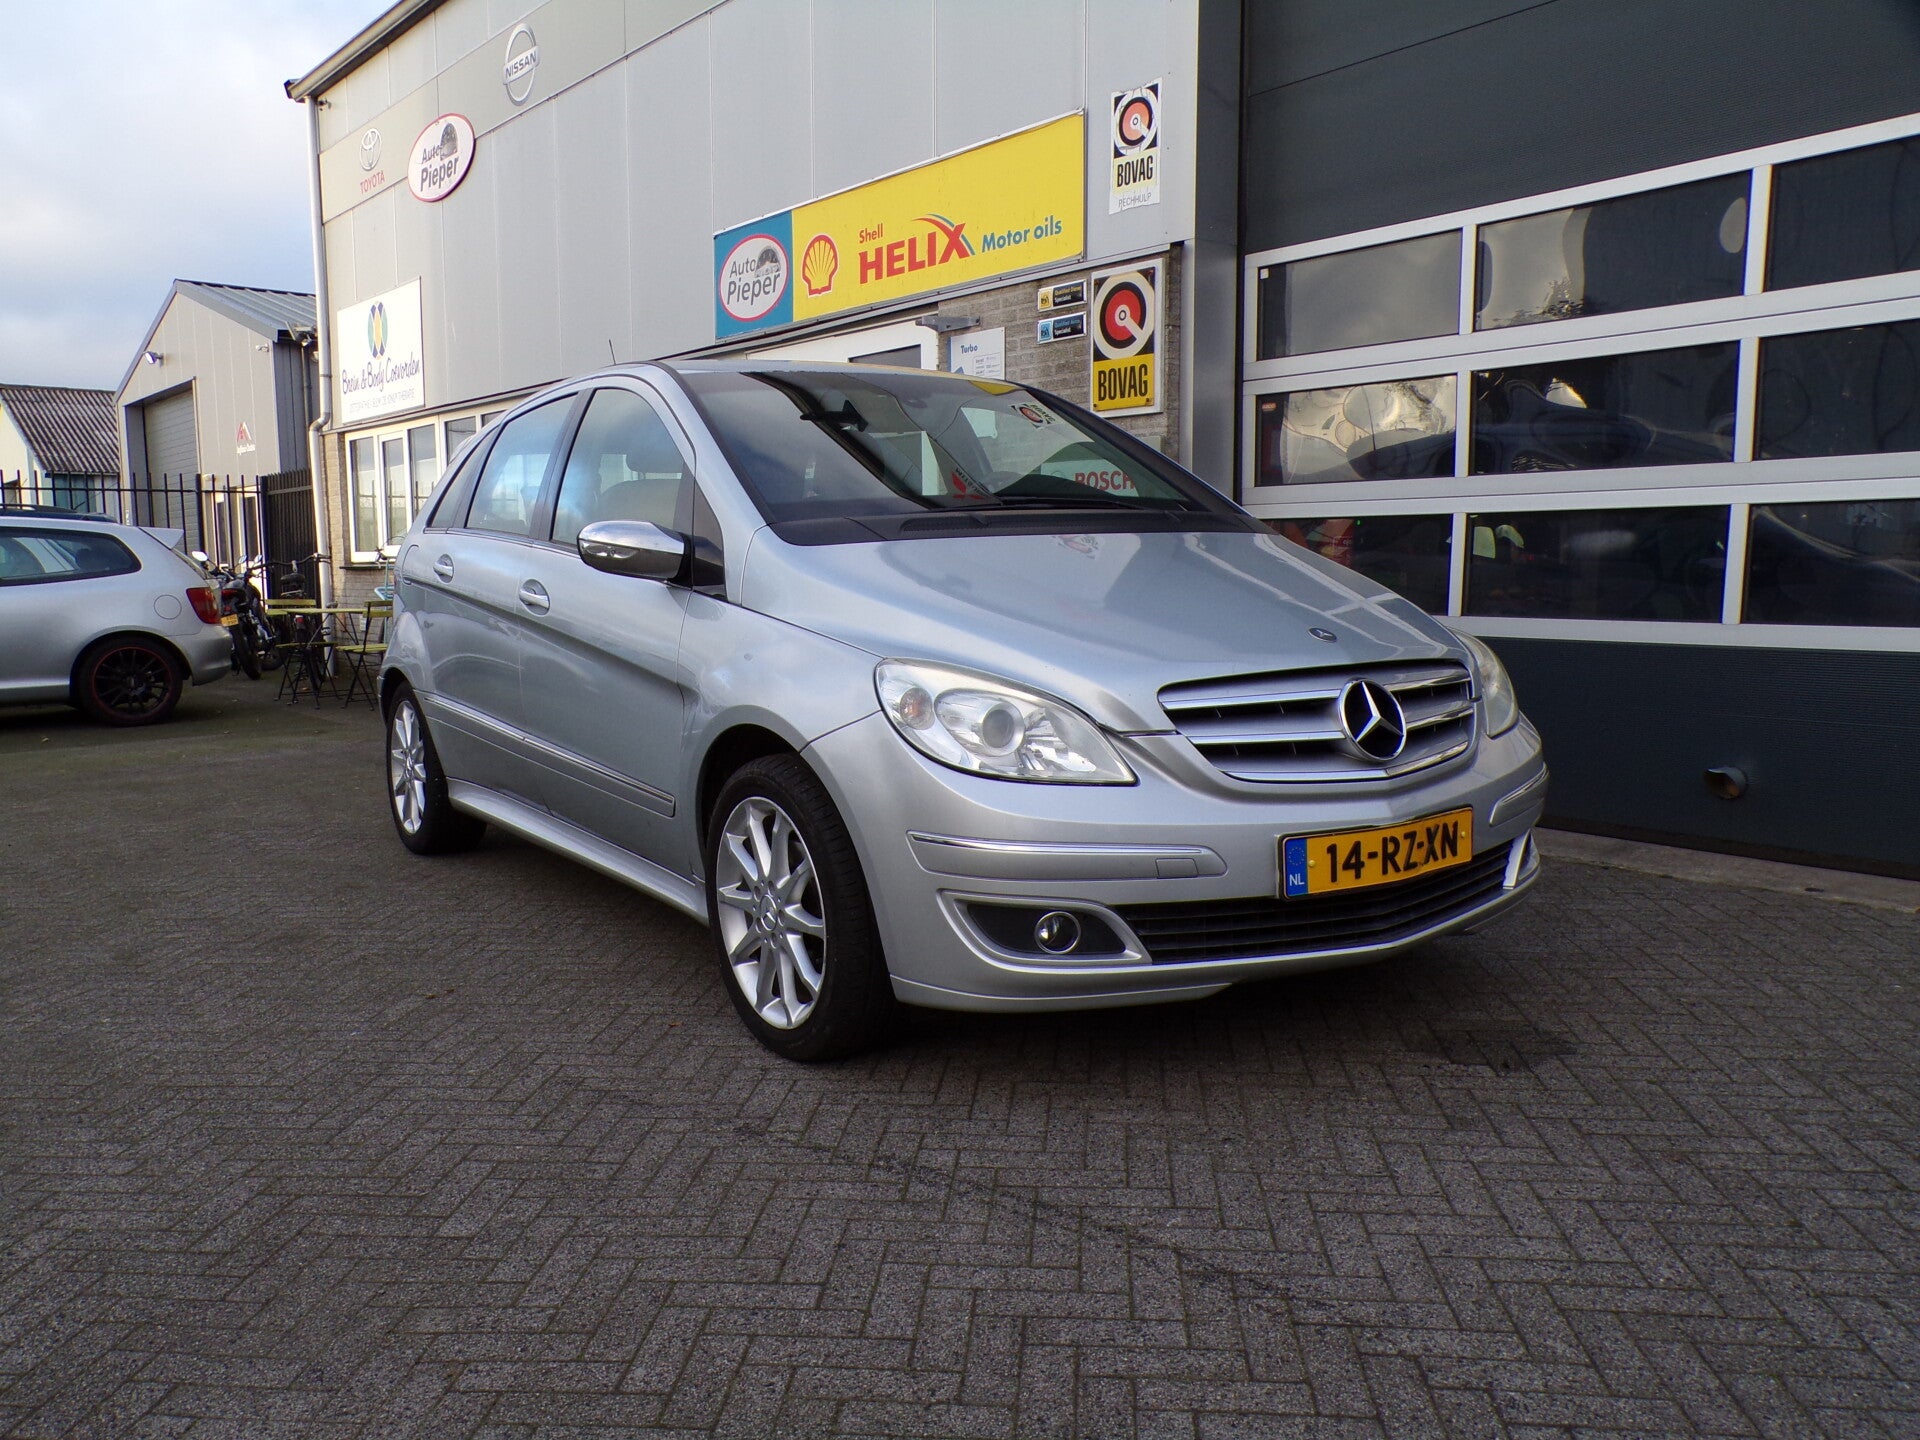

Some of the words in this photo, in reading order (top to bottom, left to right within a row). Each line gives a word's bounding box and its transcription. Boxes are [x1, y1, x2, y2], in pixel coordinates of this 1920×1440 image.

[505, 49, 537, 78] NISSAN
[421, 145, 442, 165] Auto
[360, 169, 386, 194] TOYOTA
[420, 155, 460, 192] Pieper
[1117, 155, 1154, 188] BOVAG
[1118, 192, 1152, 208] PECHHULP
[859, 223, 884, 244] Shell
[859, 221, 971, 285] HELIX
[981, 226, 1030, 254] Motor
[1033, 214, 1063, 241] oils
[730, 255, 758, 279] Auto
[726, 268, 781, 307] Pieper
[961, 344, 979, 354] Turbo
[367, 361, 385, 392] Body
[386, 352, 420, 384] Coevorden
[1097, 362, 1149, 403] BOVAG
[1326, 820, 1459, 883] 14-RZ-XN
[1289, 873, 1305, 887] NL
